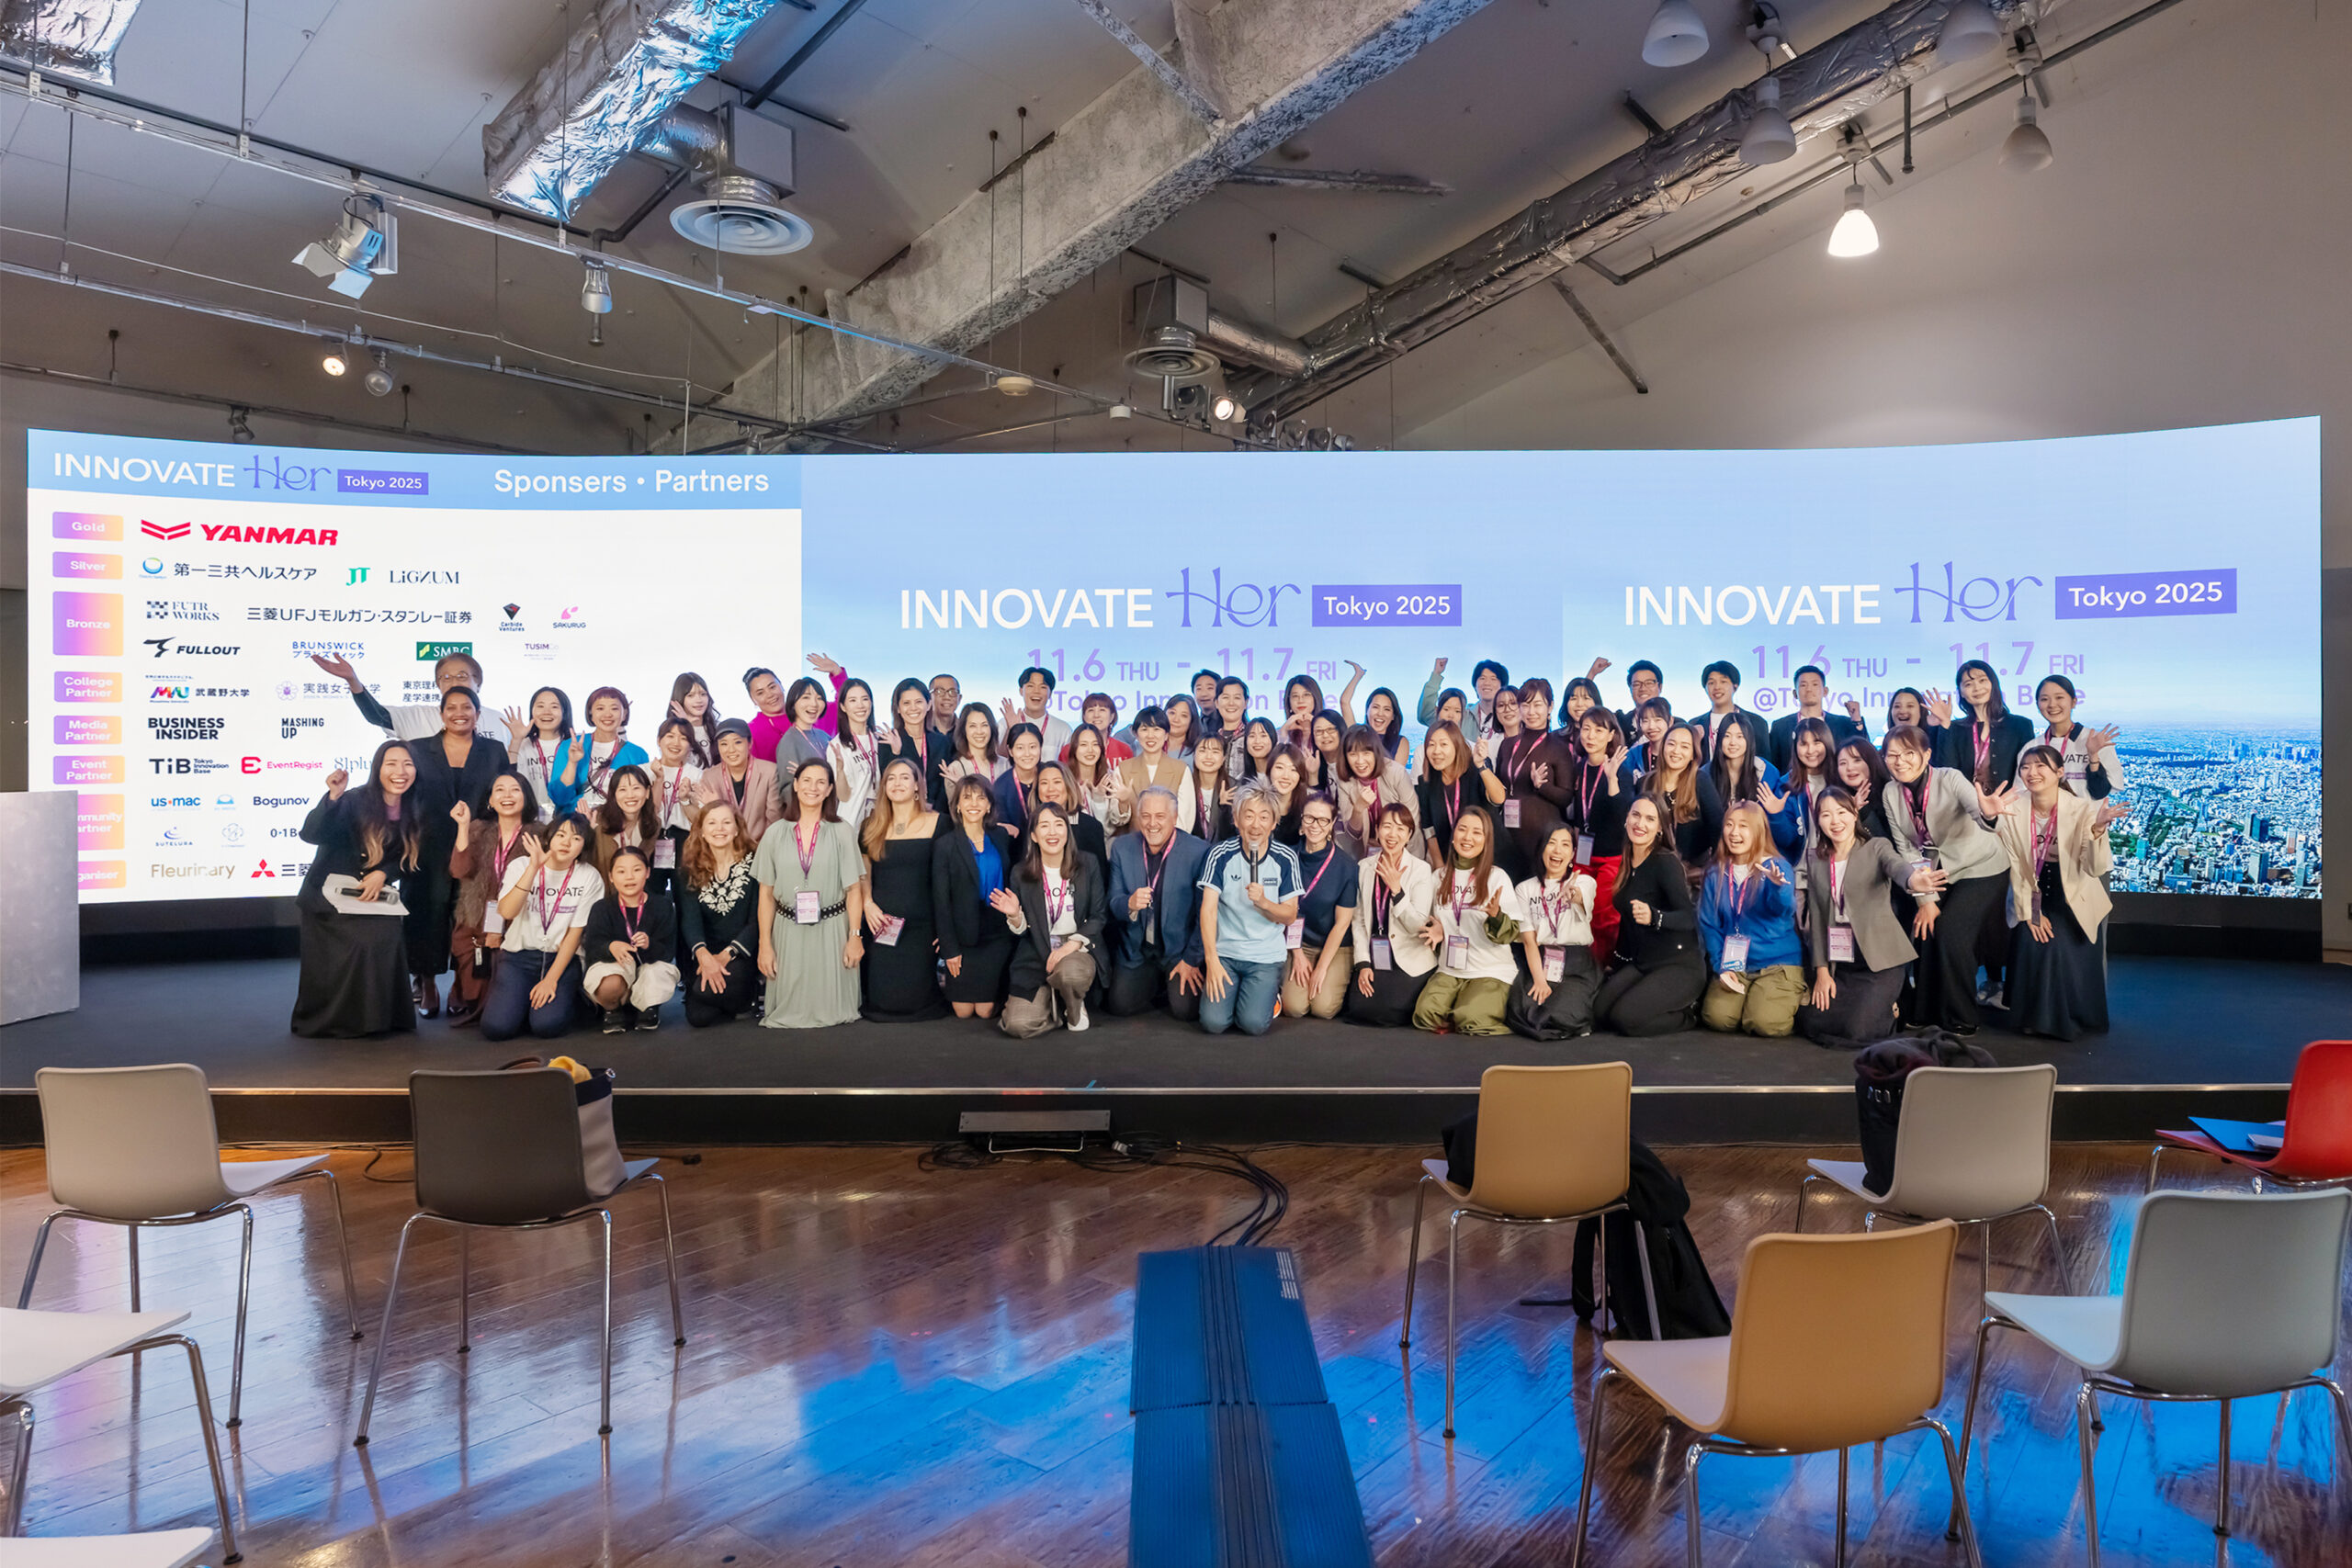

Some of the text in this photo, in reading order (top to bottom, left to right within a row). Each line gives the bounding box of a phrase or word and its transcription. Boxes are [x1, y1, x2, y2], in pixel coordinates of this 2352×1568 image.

[54, 452, 423, 491] INNOVATE Her Tokyo 2025
[494, 468, 628, 498] Sponsers
[655, 469, 770, 492] Partners
[71, 521, 106, 533] Gold
[200, 524, 338, 547] YANMAR
[70, 560, 107, 571] Silver
[174, 562, 317, 581] 第一三共ヘルスケア
[345, 567, 371, 586] JT
[900, 566, 1451, 629] INNOVATE Her Tokyo 2025
[1625, 560, 2223, 626] INNOVATE Her Tokyo 2025
[172, 601, 209, 611] FUTR
[173, 611, 220, 621] WORKS
[66, 618, 111, 629] Bronze
[176, 645, 241, 656] FULLOUT
[291, 641, 365, 650] BRUNSWICK
[1027, 648, 1106, 682] 11.6
[1115, 661, 1159, 682] THU
[1216, 647, 1294, 682] 11.7
[1306, 660, 1337, 682] FRI
[1841, 658, 1888, 679] THU
[1948, 640, 2035, 676] 11.7
[2048, 653, 2085, 675] FRI
[63, 676, 114, 687] College
[65, 688, 112, 697] Partner
[195, 688, 250, 697] 武蔵野大学
[303, 682, 381, 694] 実践女子学
[68, 720, 107, 729] Media
[147, 717, 225, 728] BUSINESS
[281, 717, 324, 728] MASHING
[65, 731, 111, 740] Partner
[155, 728, 219, 739] INSIDER
[281, 728, 298, 739] UP
[72, 760, 107, 769] Event
[149, 758, 191, 774] TiB
[266, 761, 322, 770] EventRegist
[66, 771, 113, 781] Partner
[253, 795, 310, 808] Bogunov
